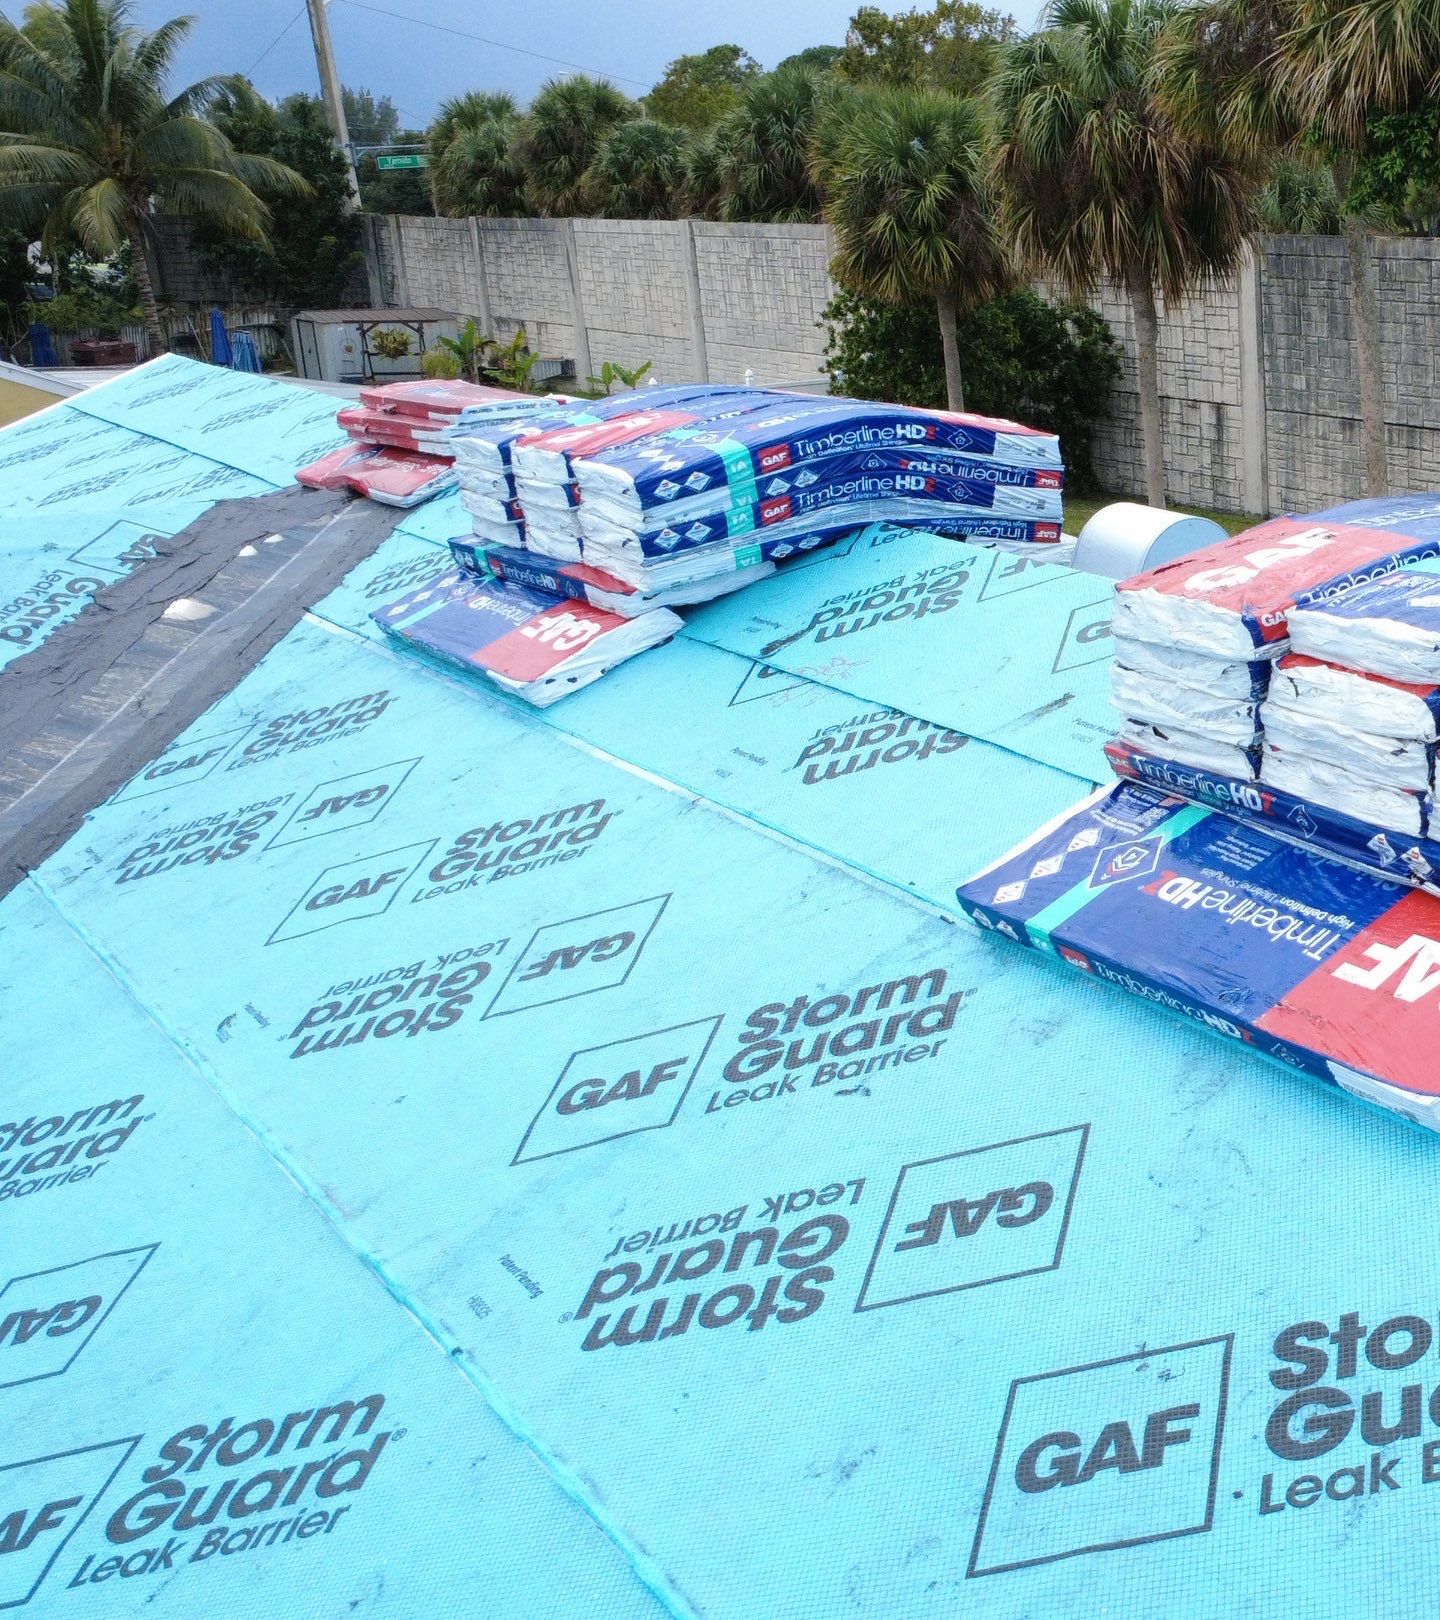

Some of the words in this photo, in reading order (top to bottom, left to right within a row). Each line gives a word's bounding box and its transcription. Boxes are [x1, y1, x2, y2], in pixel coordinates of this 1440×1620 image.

[761, 452, 788, 466] GAF
[763, 503, 788, 518] GAF
[919, 556, 978, 582] Leak
[1185, 527, 1340, 592] GAF
[813, 587, 966, 644] Storm
[822, 573, 917, 609] Barrier
[1261, 611, 1288, 627] GA
[519, 612, 601, 651] GAF
[243, 699, 393, 756] Guard
[268, 689, 390, 739] Storm
[144, 745, 229, 781] GAF
[225, 750, 281, 773] Leak
[290, 722, 371, 752] Barrier
[794, 716, 947, 770] uard
[143, 811, 232, 842] Barrier
[235, 792, 296, 819] Leak
[296, 784, 391, 823] GAF
[444, 798, 606, 857] Storm
[115, 832, 262, 885] Storm
[116, 810, 279, 871] Guard
[428, 812, 615, 883] Guard
[305, 866, 409, 911] GAF
[410, 873, 481, 904] Leak
[487, 843, 595, 884] Barrier
[1327, 914, 1356, 930] High
[317, 959, 426, 1001] Barrier
[429, 937, 511, 971] Leak
[518, 930, 636, 982] GAF
[288, 961, 492, 1039] Guard
[289, 993, 475, 1059] Storm
[738, 967, 949, 1044] Storm
[723, 991, 965, 1083] Guard
[556, 1056, 688, 1116] GAF
[705, 1072, 802, 1113] Leak
[809, 1037, 948, 1088] Barrier
[0, 1115, 145, 1181] uard
[762, 1176, 868, 1225] Leak
[894, 1180, 1056, 1254] GAF
[604, 1203, 750, 1262] Barrier
[573, 1213, 851, 1321] Guard
[580, 1266, 836, 1353] Storm
[142, 1394, 386, 1484] Storm
[1014, 1402, 1200, 1495] GAF
[105, 1431, 395, 1545] Guard
[1257, 1452, 1402, 1516] Leak
[66, 1536, 187, 1589] Leak
[188, 1504, 352, 1564] Barrier
